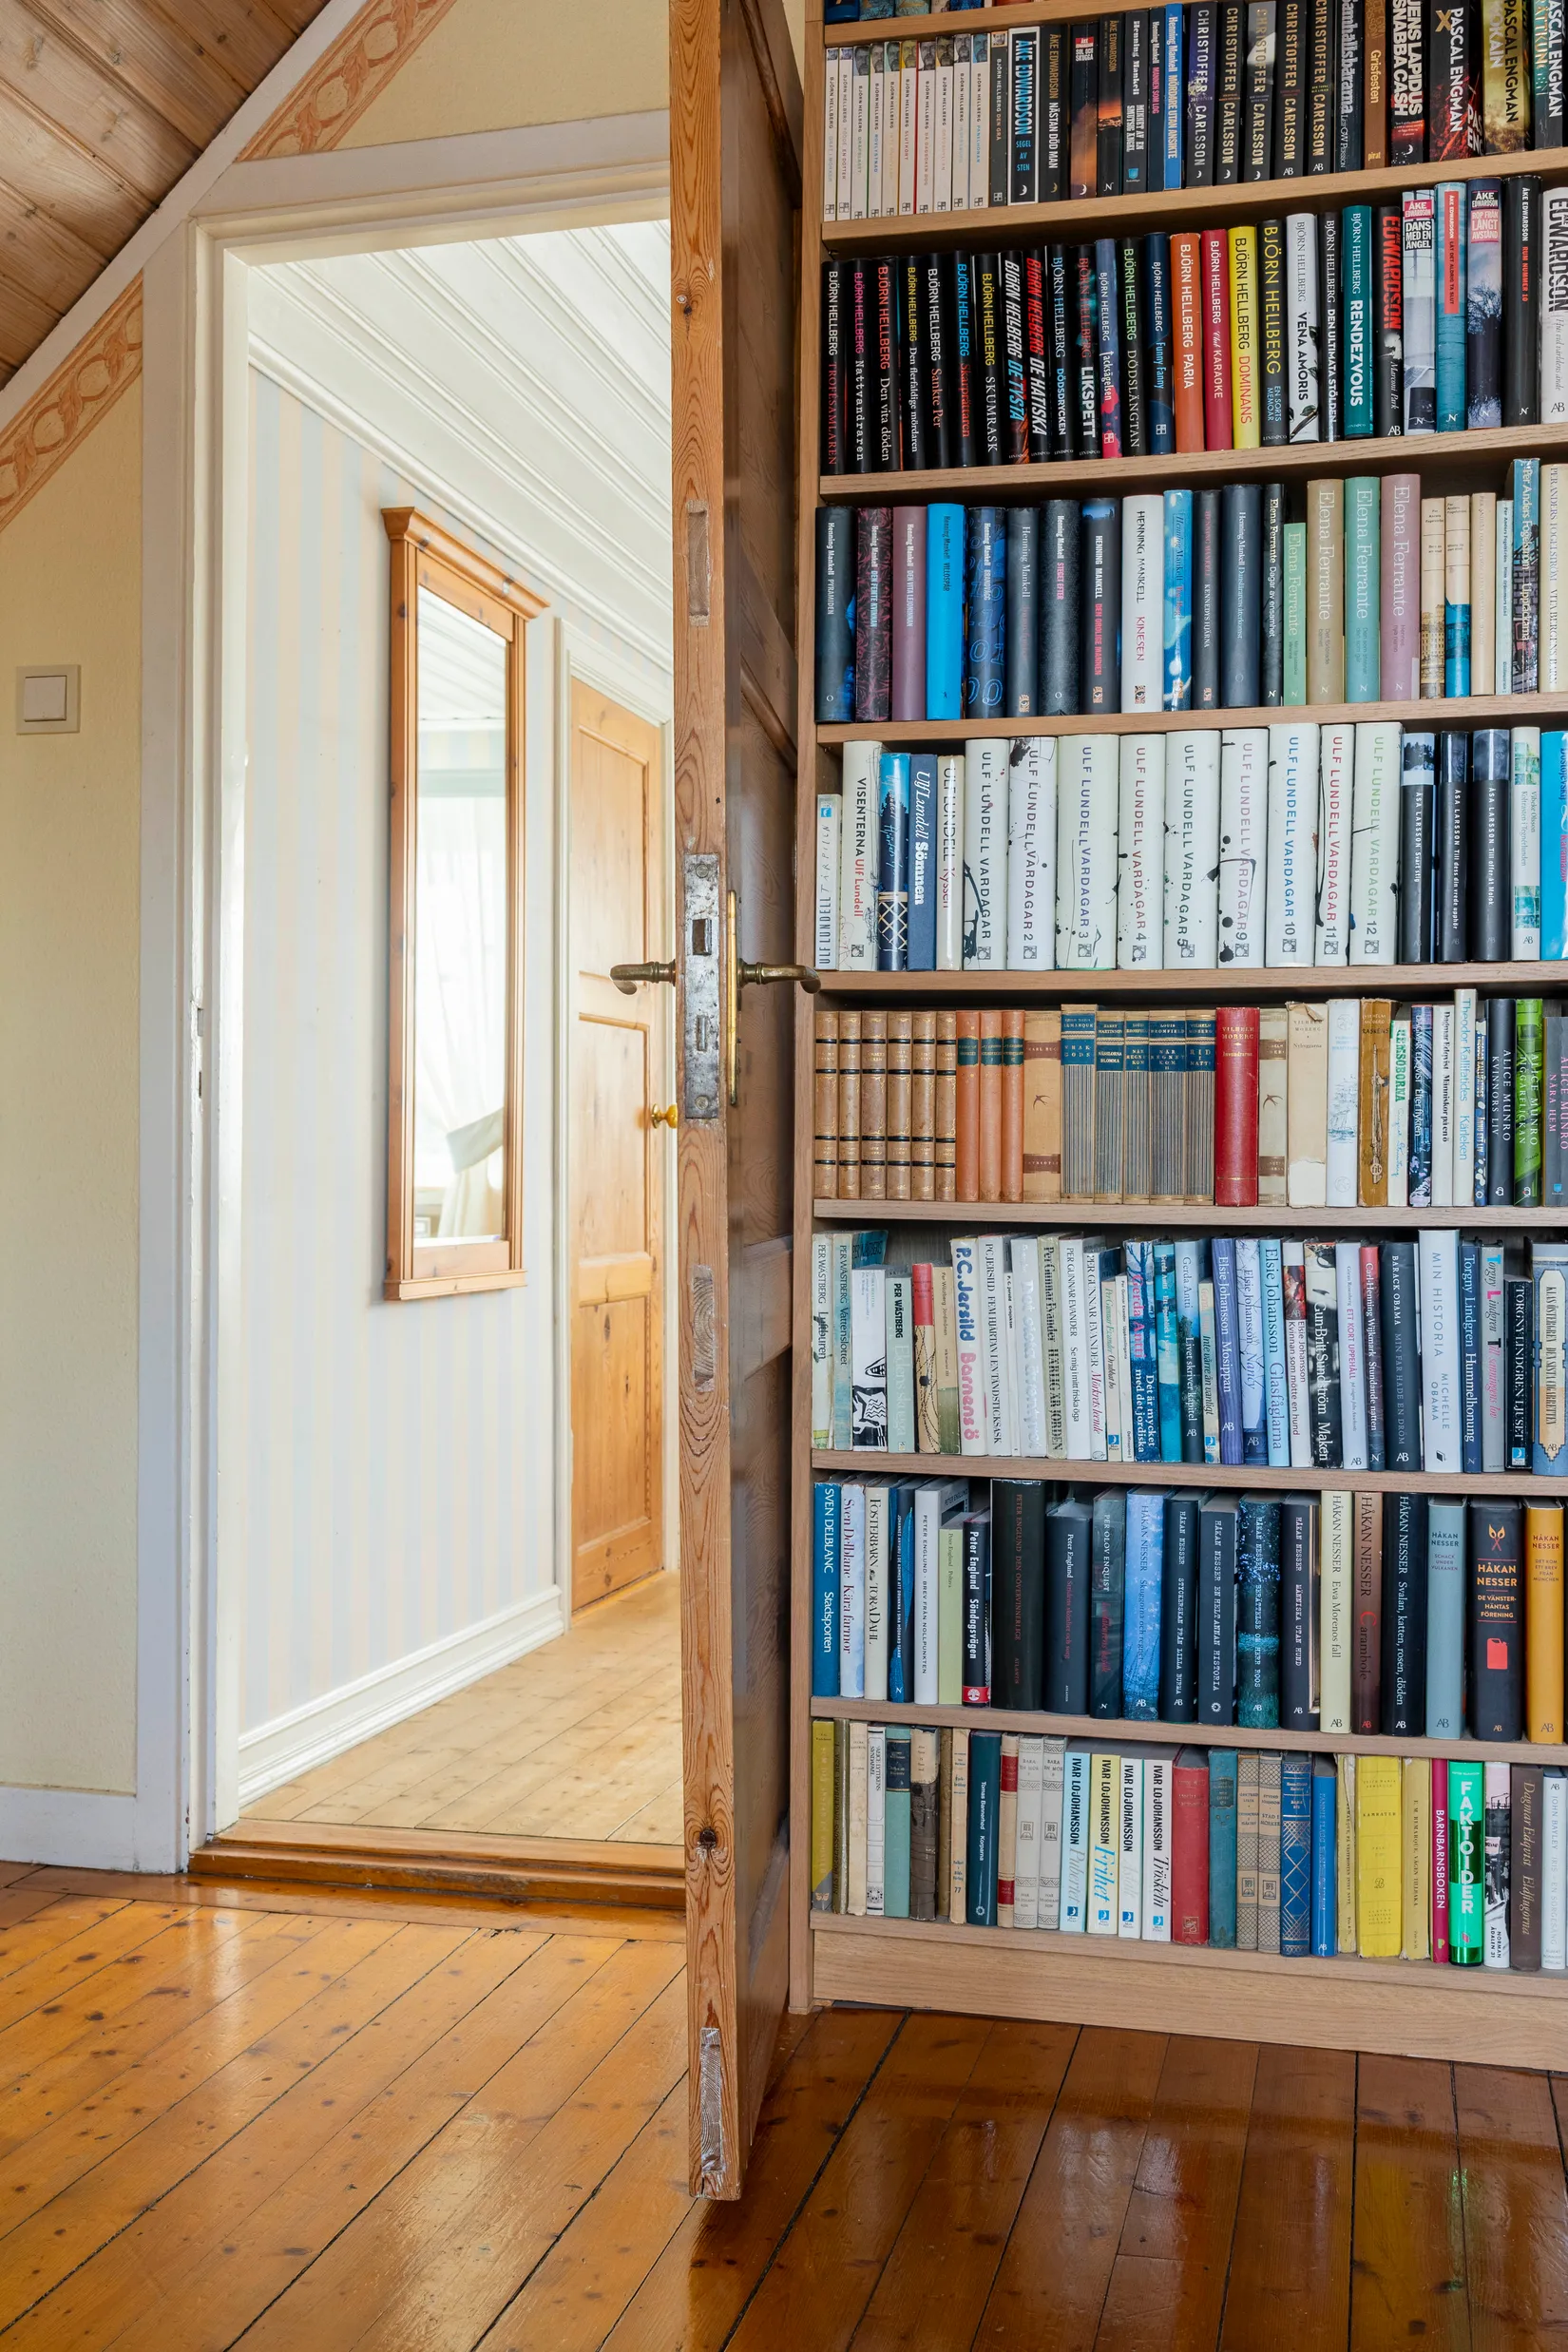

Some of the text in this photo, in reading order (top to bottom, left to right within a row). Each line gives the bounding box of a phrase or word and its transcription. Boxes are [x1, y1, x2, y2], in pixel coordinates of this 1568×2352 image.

[1015, 40, 1037, 135] ÅKE EDWARDSON
[1049, 34, 1061, 168] ÅKE EDWARDSON NÄSTAN DÖD MAN
[1167, 17, 1179, 159] Henning Mankell MÖRDARE UTAN ANSIKTE
[1222, 8, 1238, 163] CHRISTOFFER CARLSSON
[1369, 49, 1382, 103] Grisfesten
[1449, 8, 1463, 132] PASCAL ENGMAN
[1026, 258, 1047, 435] BJÖRN HELLBERG DE HATISKA
[1124, 248, 1139, 448] BJÖRN HELLBERG DÖDSLÄNGTAN
[1181, 244, 1195, 388] BJÖRN HELLBERG PARIA
[1235, 238, 1252, 424] BJÖRN HELLBERG DOMINANS
[1265, 227, 1281, 373] BJÖRN HELLBERG
[1350, 213, 1363, 406] BJÖRN HELLBERG RENDEZVOUS
[983, 274, 997, 452] BJÖRN HELLBERG SKUMRASK
[1274, 386, 1281, 396] EN
[1137, 511, 1145, 554] HENNING
[1270, 498, 1278, 524] Elena
[1270, 526, 1278, 563] Ferrante
[1393, 486, 1409, 616] Elena Ferrante
[1521, 468, 1532, 641] Per Anders Fogelström Upptäckarna
[1268, 566, 1276, 588] Dagar
[1270, 590, 1274, 599] av
[1137, 617, 1145, 660] KINESEN
[854, 778, 867, 916] VISENTERNA Ulf Lundell
[914, 771, 929, 905] Ulf Lundell Sömnen
[1133, 748, 1146, 941] ULF LUNDELL VARDAGAR 4
[1284, 737, 1298, 935] ULF LUNDELL VARDAGAR 10
[1413, 1109, 1422, 1136] flykten
[1460, 998, 1470, 1160] Theodor Kallifatides Kärleken
[840, 1259, 849, 1304] WÄSTBERG
[958, 1281, 975, 1341] Jersild
[1182, 1257, 1191, 1283] Gerda
[1183, 1286, 1192, 1308] Antti
[1219, 1256, 1232, 1392] Elsie Johansson Mosippan
[1432, 1252, 1444, 1356] MIN HISTORIA
[840, 1308, 849, 1365] Vattenslottet
[961, 1352, 976, 1424] Barnens
[1186, 1361, 1195, 1390] skriver
[1463, 1254, 1477, 1442] Torgny Lindgren Hummelhonung
[964, 1429, 979, 1440] ö
[1187, 1392, 1197, 1421] kapitel
[822, 1489, 834, 1653] SVEN DELBLANC Stadsporten
[967, 1531, 980, 1659] Peter Englund Söndagsvägen
[1396, 1496, 1411, 1705] HÅKAN NESSER Svalan, katten, rosen, döden
[1477, 1578, 1517, 1586] NESSER
[1478, 1564, 1516, 1573] HÅKAN
[1153, 1766, 1162, 1785] IVAR
[1153, 1857, 1169, 1907] Tröskeln
[1435, 1809, 1445, 1908] BARNBARNSBOKEN
[1460, 1782, 1474, 1914] FAKTOIDER
[1520, 1782, 1535, 1935] Dagmar Edqvist Eldflugorna
